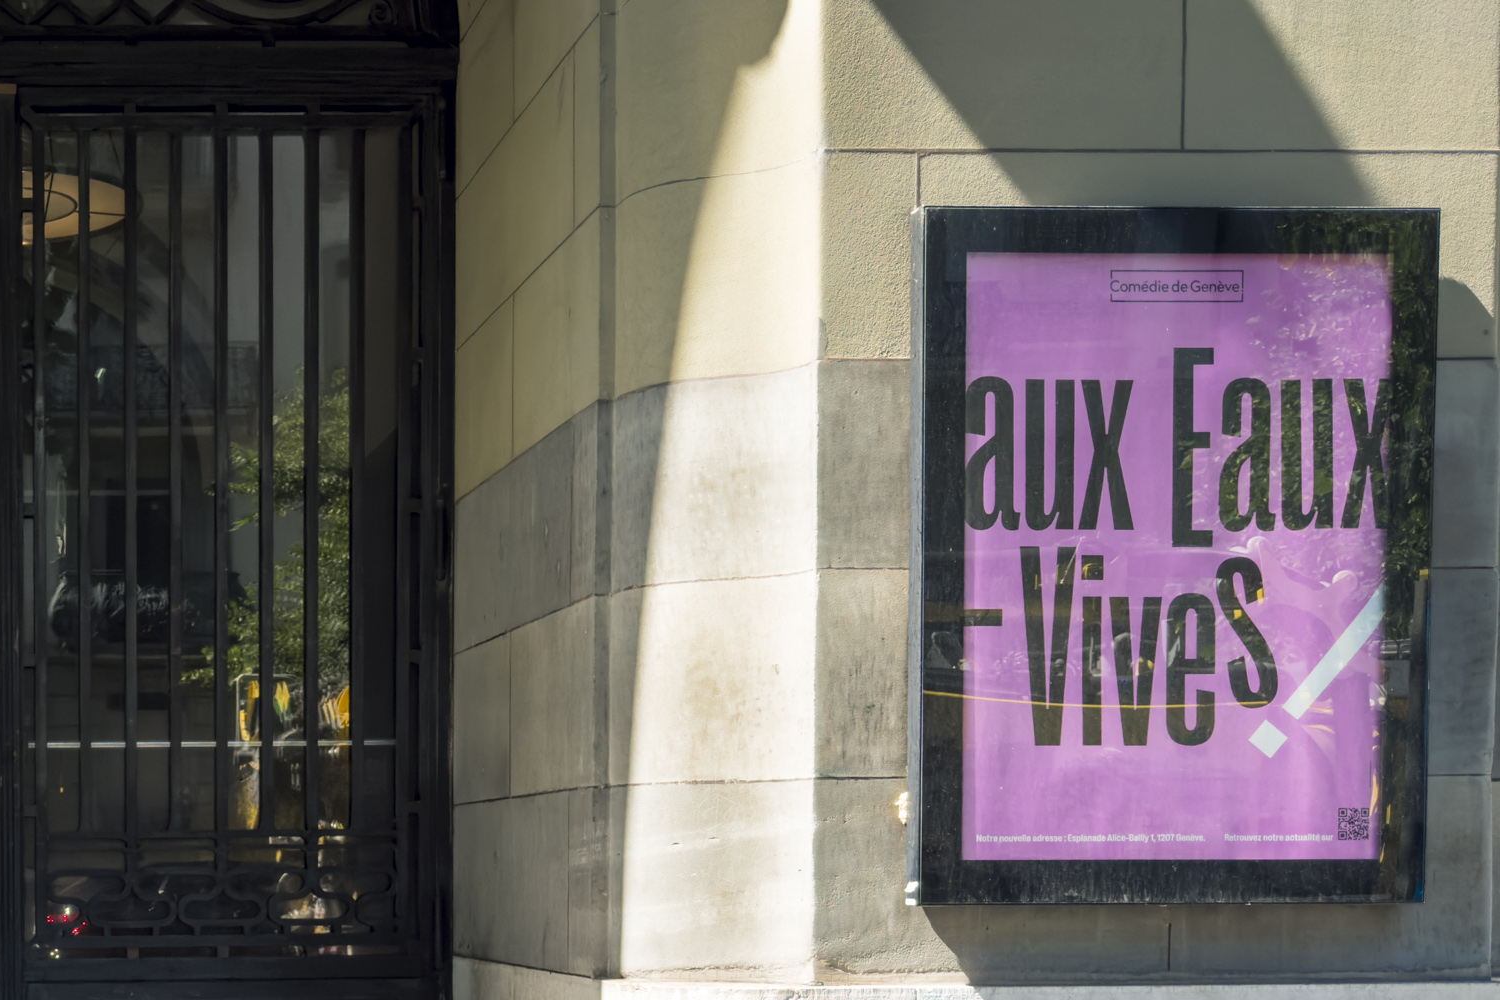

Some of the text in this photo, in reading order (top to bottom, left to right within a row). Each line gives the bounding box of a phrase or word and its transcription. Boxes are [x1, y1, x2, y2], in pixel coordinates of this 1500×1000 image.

[1110, 280, 1169, 292] Comédie
[1171, 280, 1188, 292] de
[965, 347, 1388, 548] aux Eaux
[976, 834, 998, 843] Notre
[999, 834, 1031, 843] nouvelle
[1032, 834, 1063, 842] adresse
[1067, 834, 1106, 844] Esplanade
[1107, 833, 1149, 844] Alice-Bailly
[1157, 834, 1175, 842] 1207
[1224, 833, 1334, 842] Retrouvez notre actualité sur
